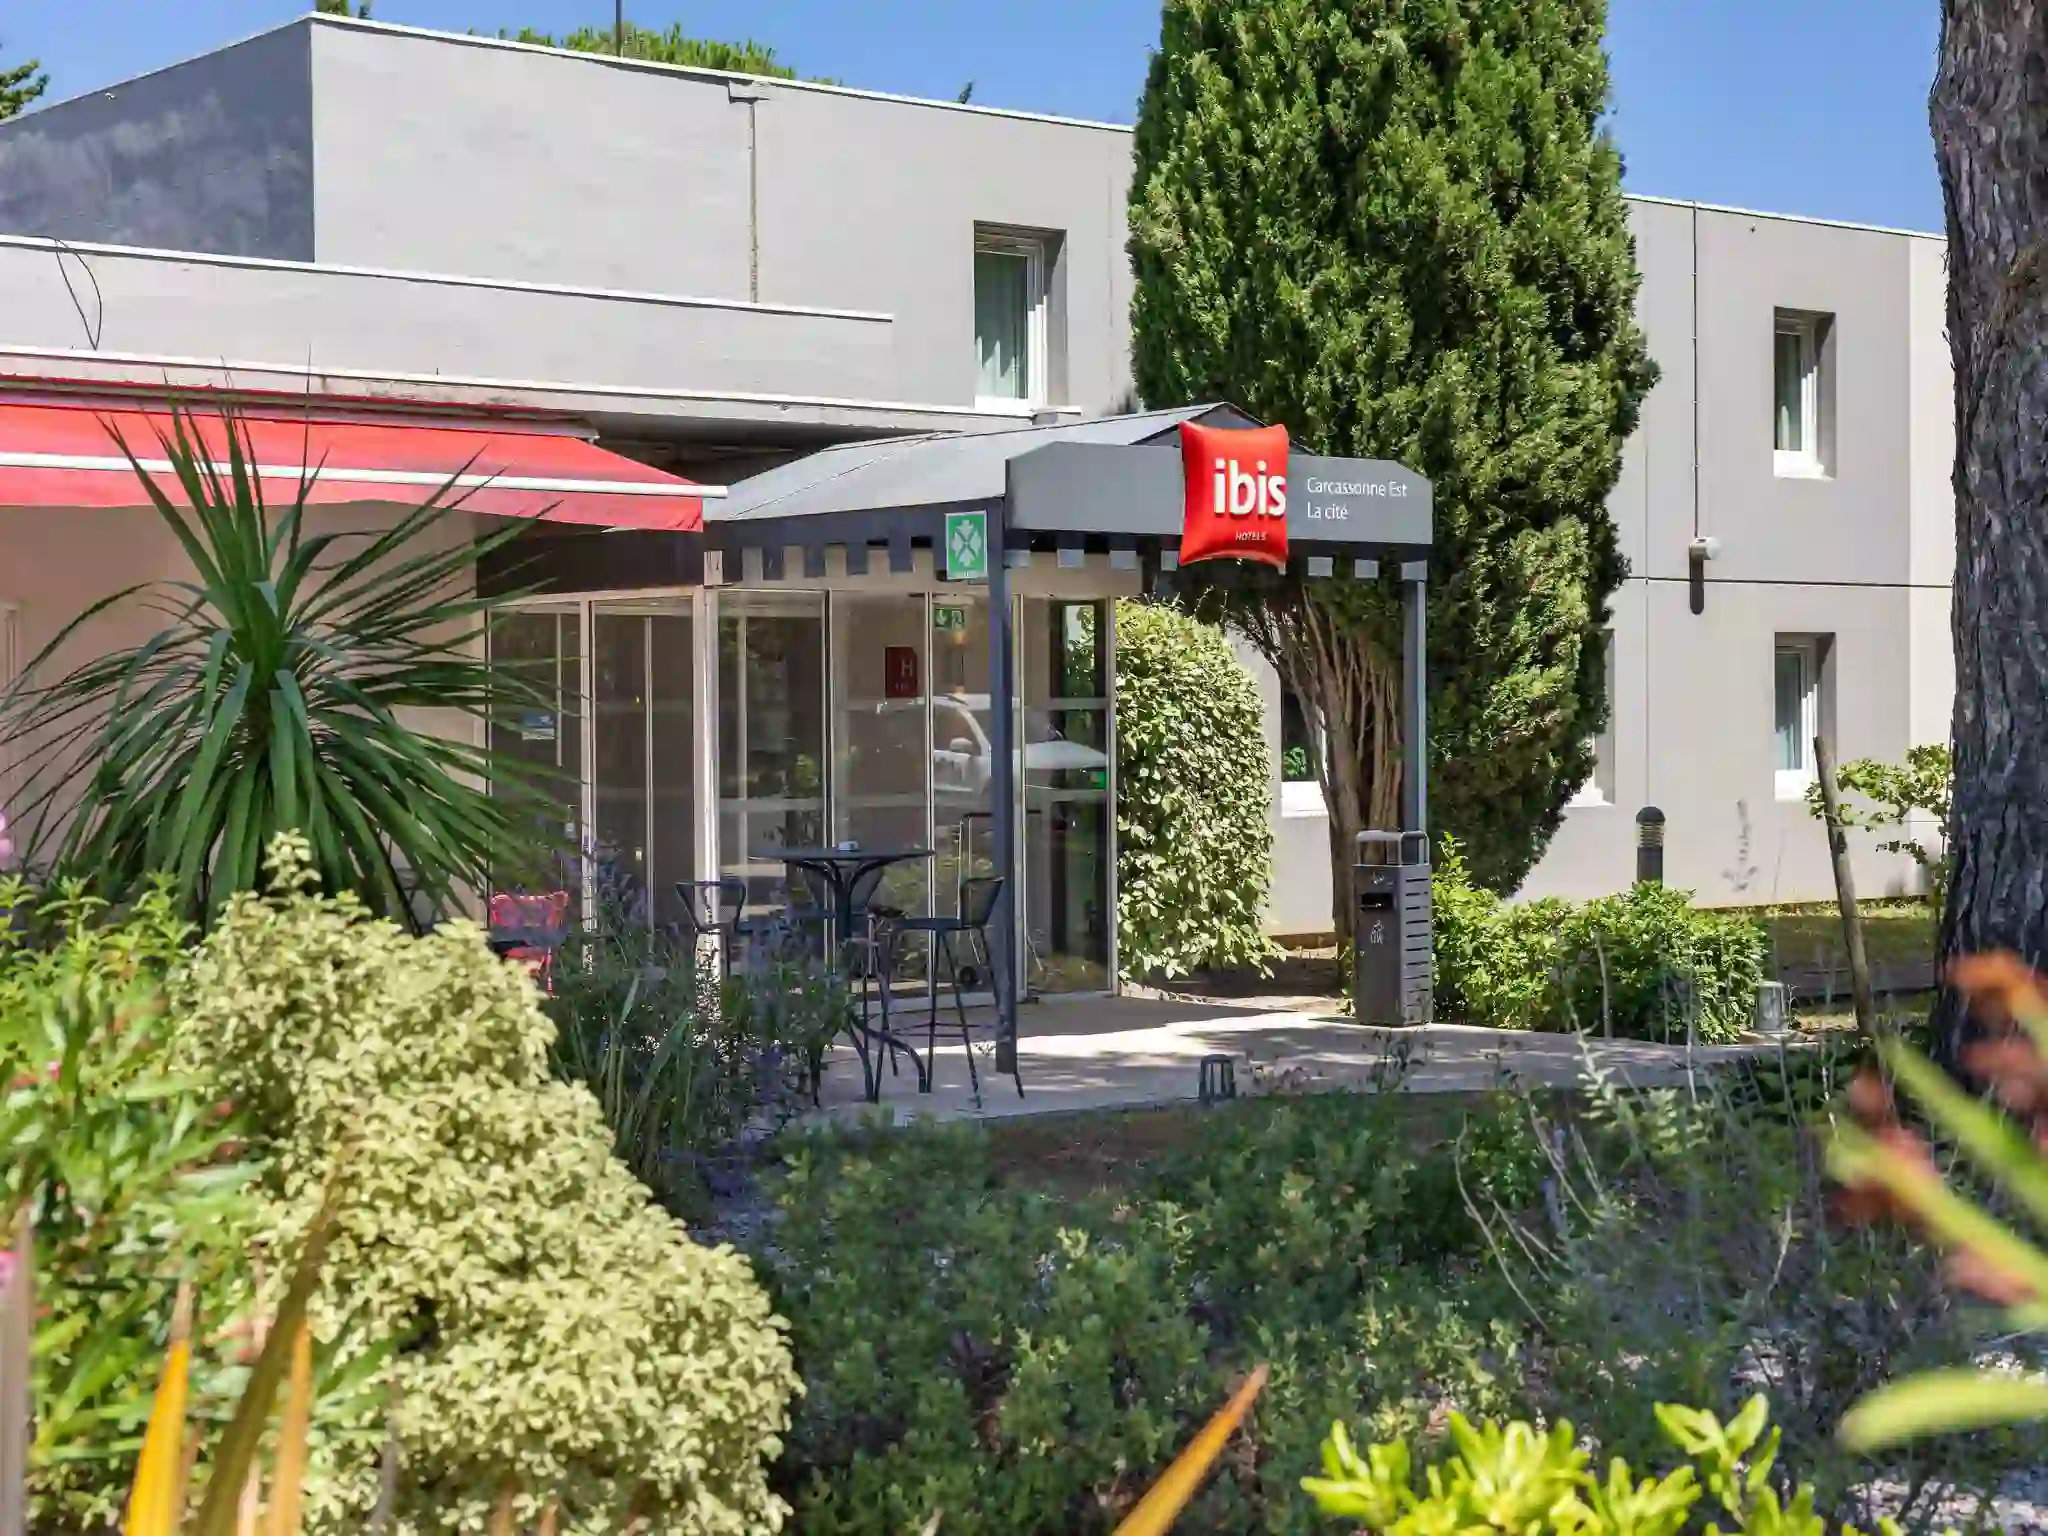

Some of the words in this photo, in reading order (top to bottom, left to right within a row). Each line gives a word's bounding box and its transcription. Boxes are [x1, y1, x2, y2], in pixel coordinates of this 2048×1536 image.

[1213, 458, 1287, 517] ibis
[1307, 476, 1386, 496] Carcassonne
[1389, 480, 1407, 498] Est
[1307, 501, 1321, 519] La
